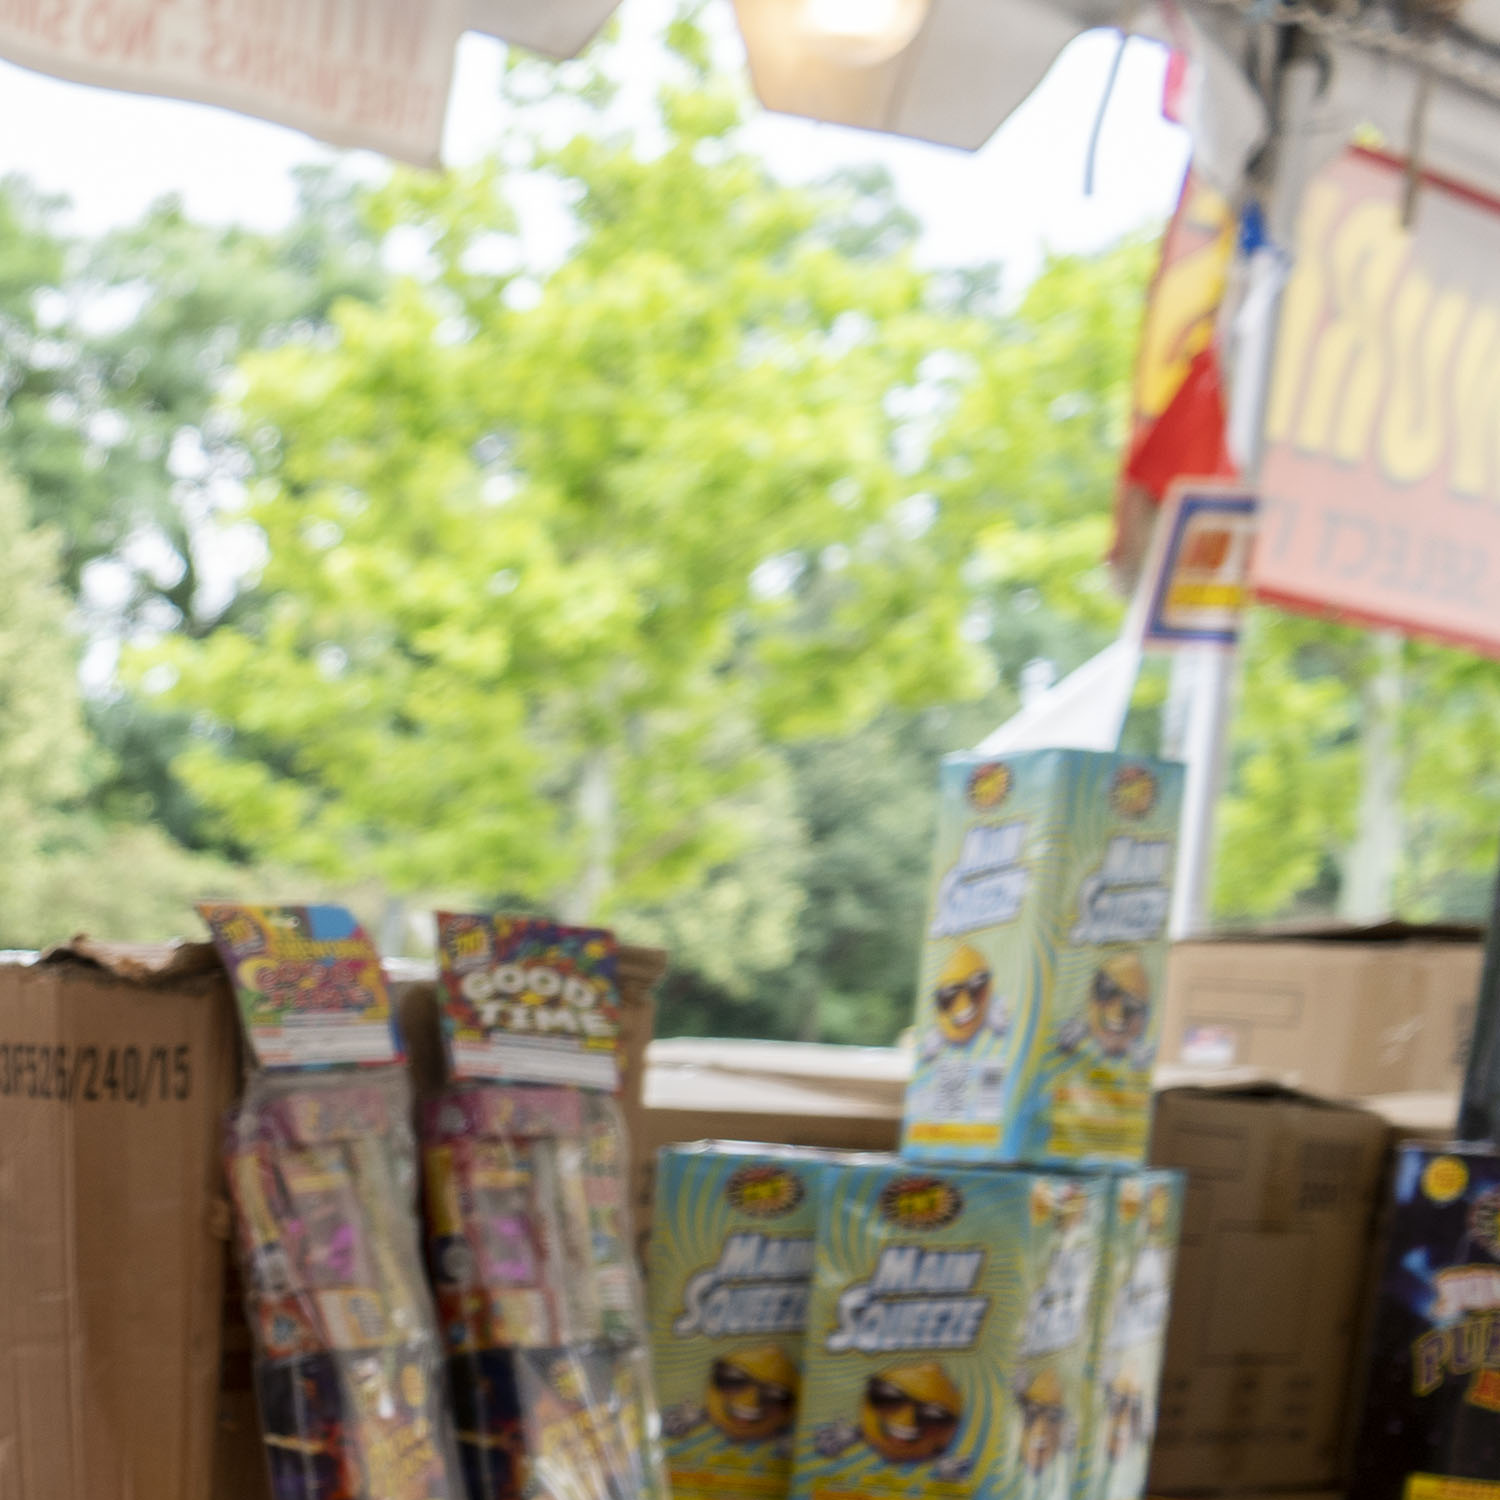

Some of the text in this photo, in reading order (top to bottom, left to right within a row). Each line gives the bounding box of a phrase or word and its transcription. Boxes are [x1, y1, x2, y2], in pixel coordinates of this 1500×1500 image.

[461, 962, 597, 1009] GOOD
[478, 1000, 619, 1037] TIME
[866, 1246, 986, 1296] MAIN
[827, 1284, 991, 1353] SQUEEZE
